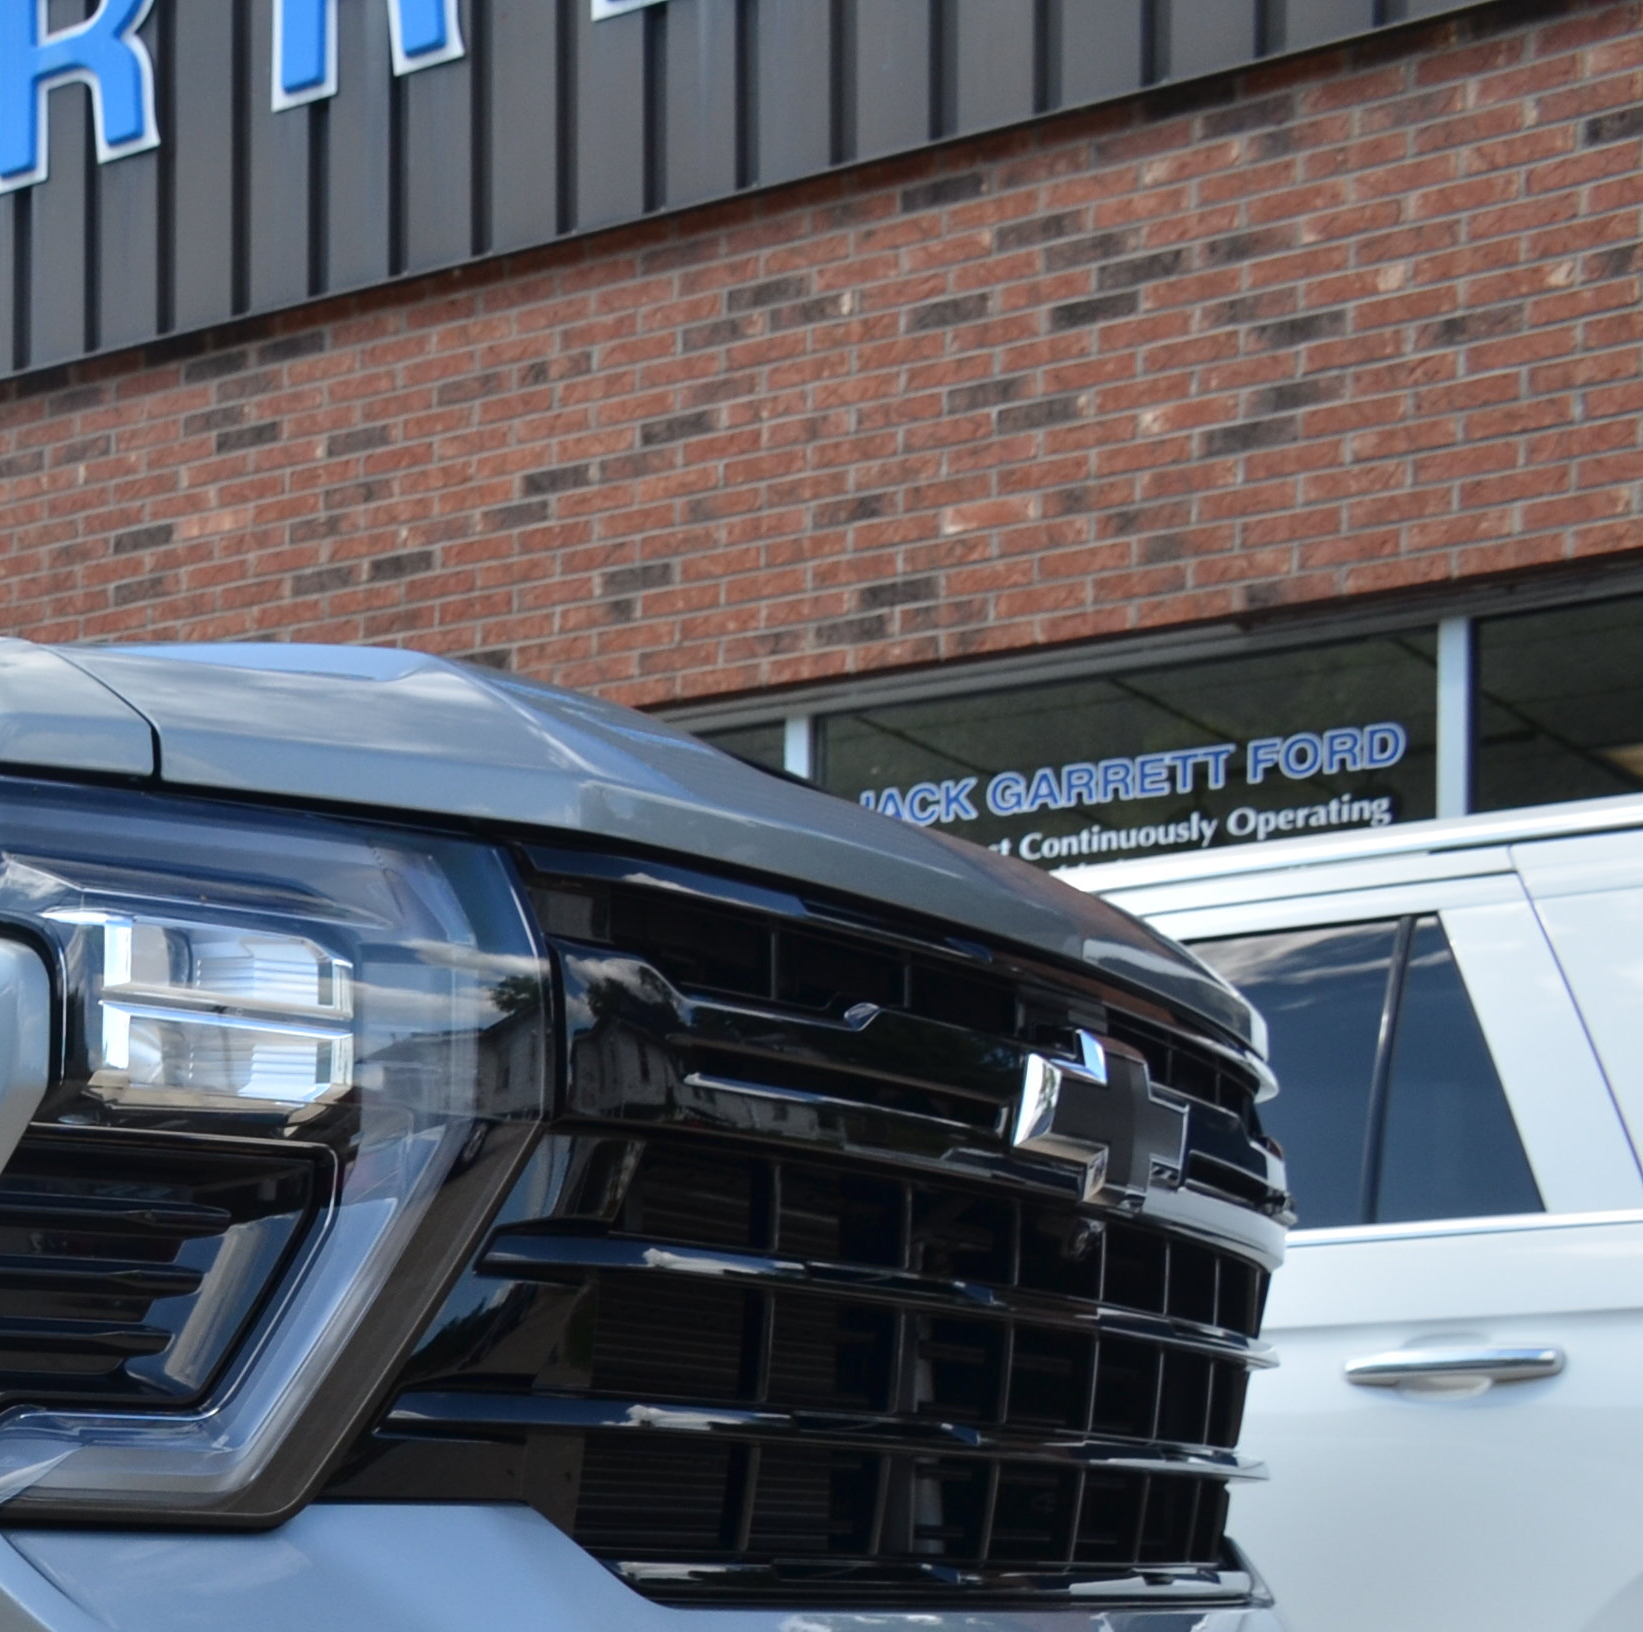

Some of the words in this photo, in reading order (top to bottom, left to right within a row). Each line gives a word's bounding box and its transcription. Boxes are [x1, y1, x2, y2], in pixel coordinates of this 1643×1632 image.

[986, 743, 1236, 816] GARRETT
[1246, 722, 1406, 784] FORD
[1019, 808, 1217, 861] Continuously
[1226, 795, 1392, 841] Operating
